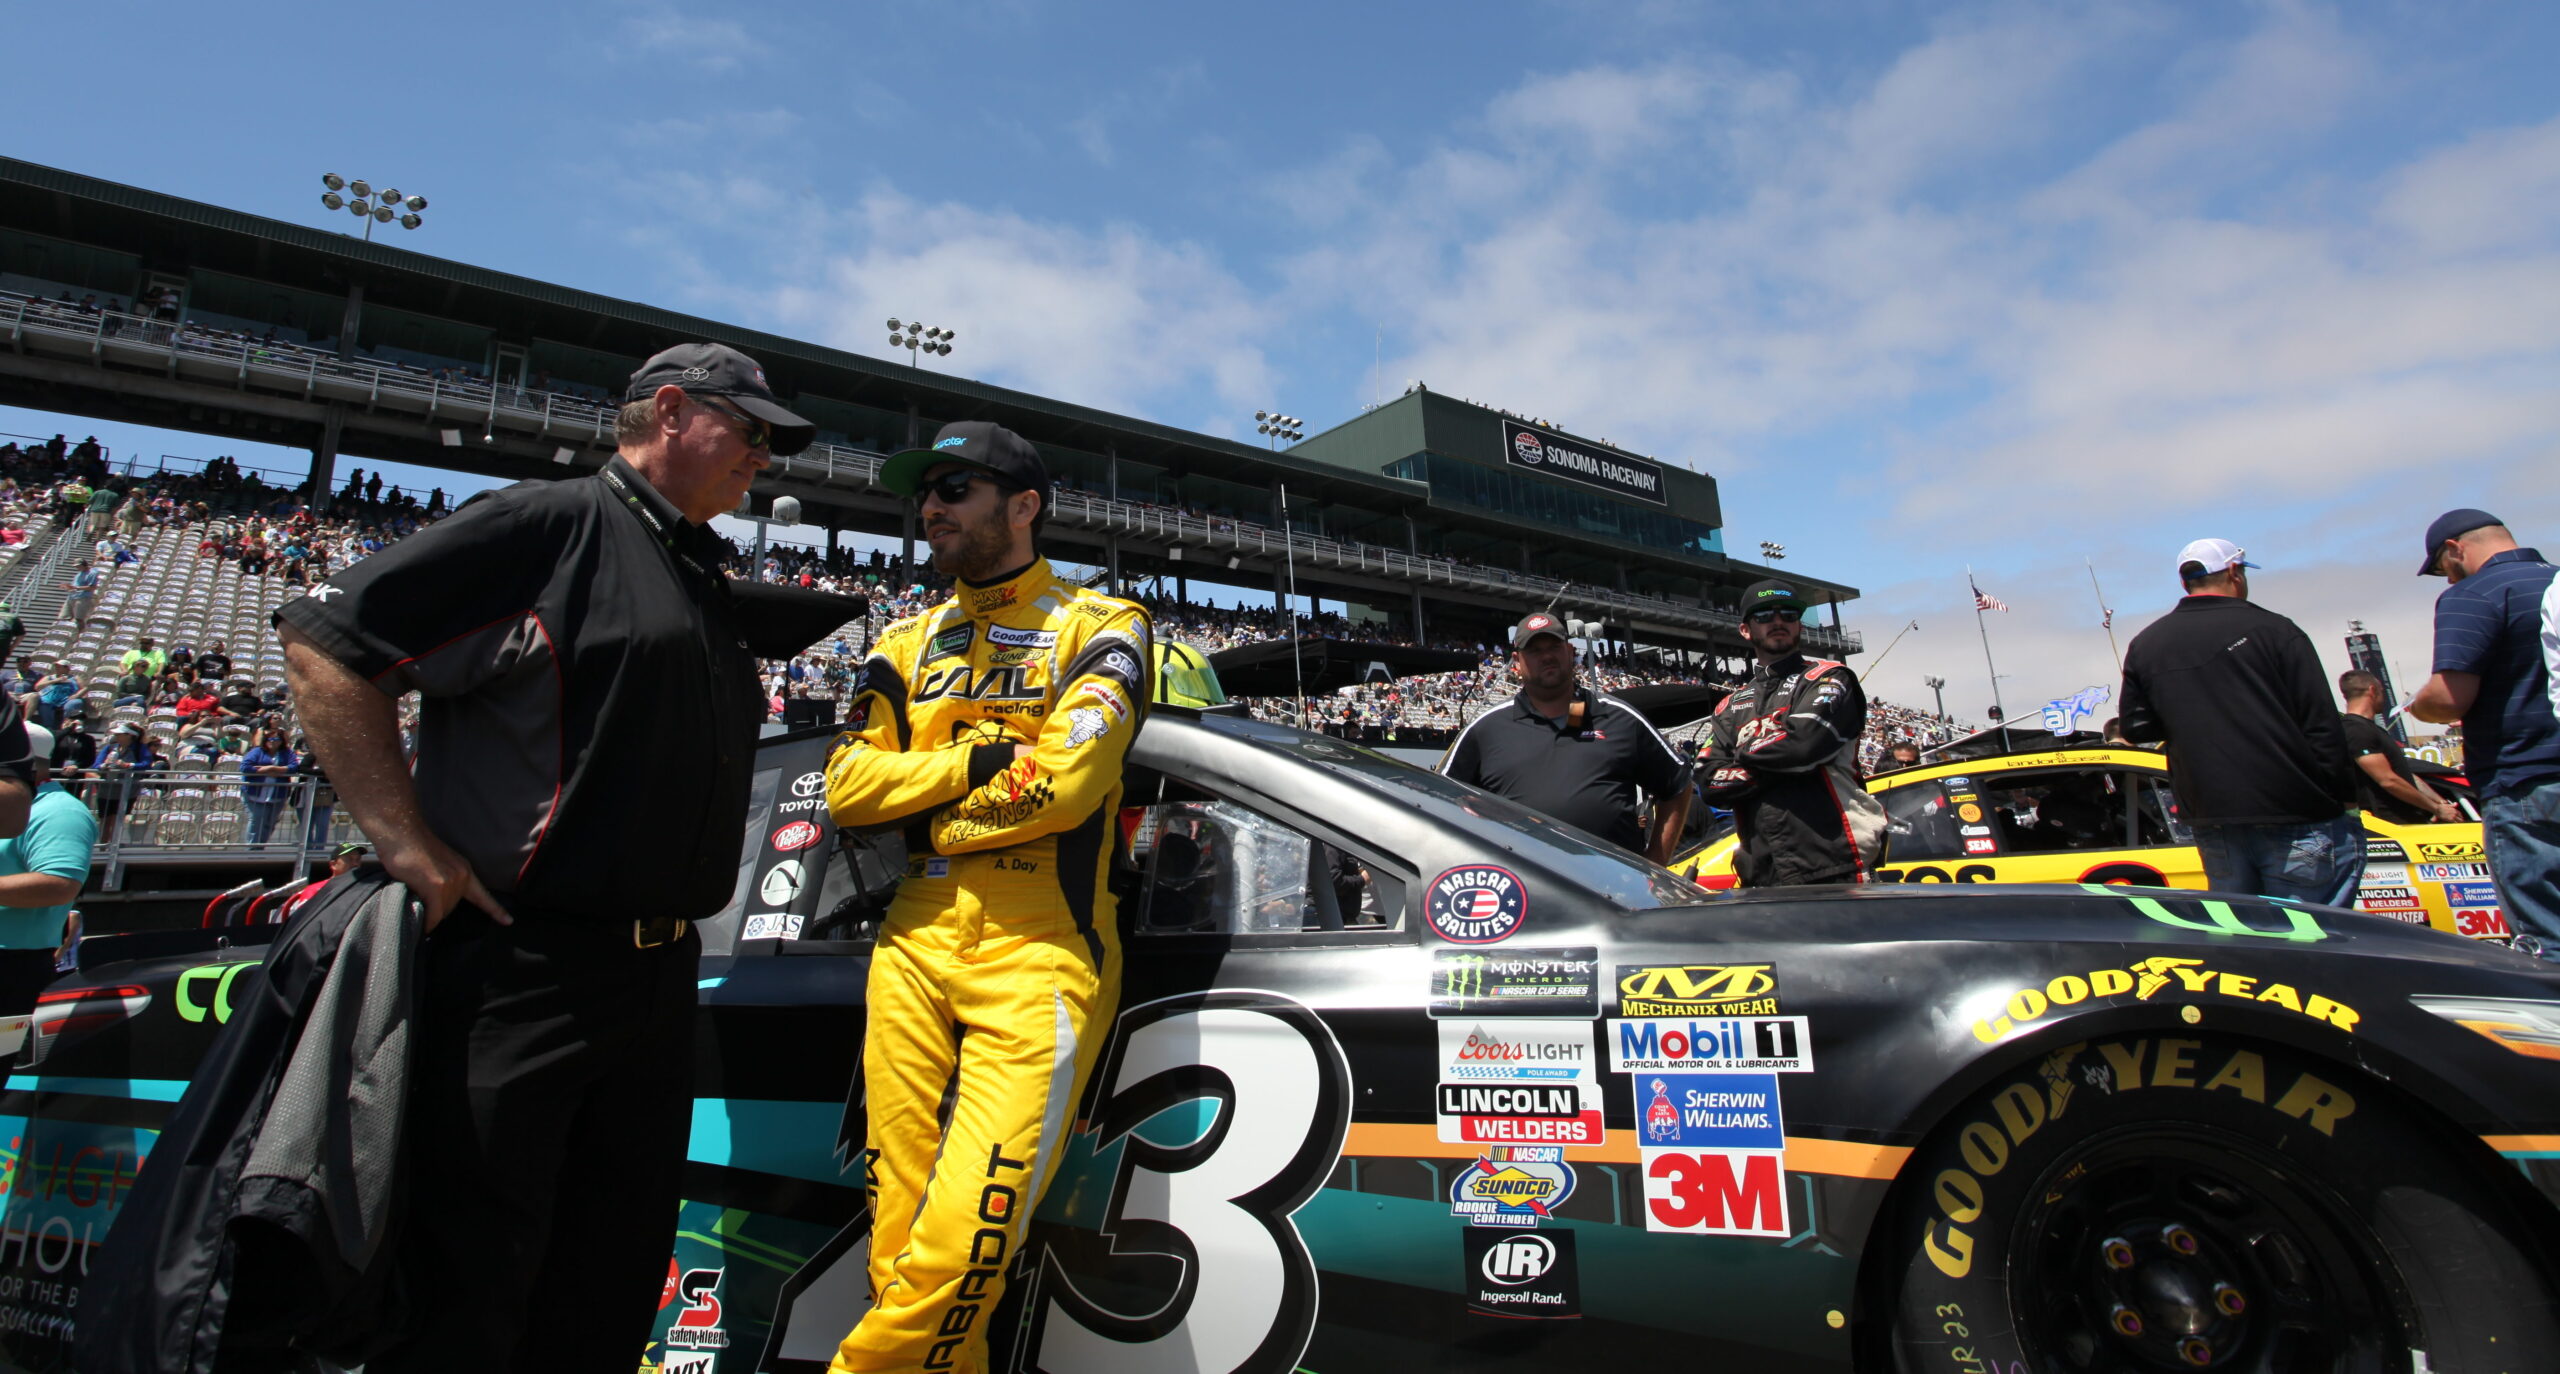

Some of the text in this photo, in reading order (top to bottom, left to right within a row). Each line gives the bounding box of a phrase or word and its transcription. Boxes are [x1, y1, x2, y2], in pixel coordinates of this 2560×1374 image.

[1546, 446, 1656, 492] SONOMA RACEWAY
[1078, 604, 1109, 617] OMP
[888, 623, 918, 639] OMP
[992, 631, 1055, 643] GOODYEAR
[994, 650, 1041, 661] SUNOCO
[1106, 653, 1139, 682] OMP
[984, 703, 1044, 716] racing
[779, 799, 829, 813] TOYOTA
[948, 795, 1032, 844] RACING
[1967, 840, 1994, 852] SEM
[1011, 859, 1037, 873] Day
[2420, 864, 2468, 877] Mobil
[1439, 871, 1511, 896] NASCAR
[767, 915, 801, 932] JAS
[1436, 912, 1514, 937] SALUTES
[2457, 911, 2509, 935] 3M
[1491, 960, 1590, 975] MONSTER
[1502, 986, 1588, 995] NASCAR CUP SERIES
[1622, 998, 1777, 1016] MECHANIX WEAR
[1972, 957, 2360, 1043] GOODYEAR
[1458, 1035, 1584, 1060] Coors LIGHT
[1620, 1021, 1783, 1059] Mobil 1
[1527, 1069, 1568, 1077] POLE AWARD
[1623, 1060, 1799, 1068] OFFICIAL MOTOR OIL & LUBRICANTS
[1445, 1088, 1571, 1114] LINCOLN
[1685, 1090, 1765, 1108] SHERWIN
[1685, 1109, 1768, 1128] WILLIAMS
[1474, 1119, 1588, 1140] WELDERS
[1512, 1147, 1559, 1162] NASCAR
[1923, 1036, 2356, 1278] GOODYEAR
[1476, 1180, 1550, 1196] SUNOCO
[1649, 1153, 1784, 1232] 3M
[1454, 1202, 1498, 1214] ROOKIE
[1473, 1213, 1535, 1225] CONTENDER
[922, 1143, 1025, 1374] ABADOT
[1494, 1243, 1543, 1276] IR
[31, 1280, 63, 1305] THE
[1481, 1290, 1530, 1304] Ingersoll
[1936, 1303, 1969, 1338] 23
